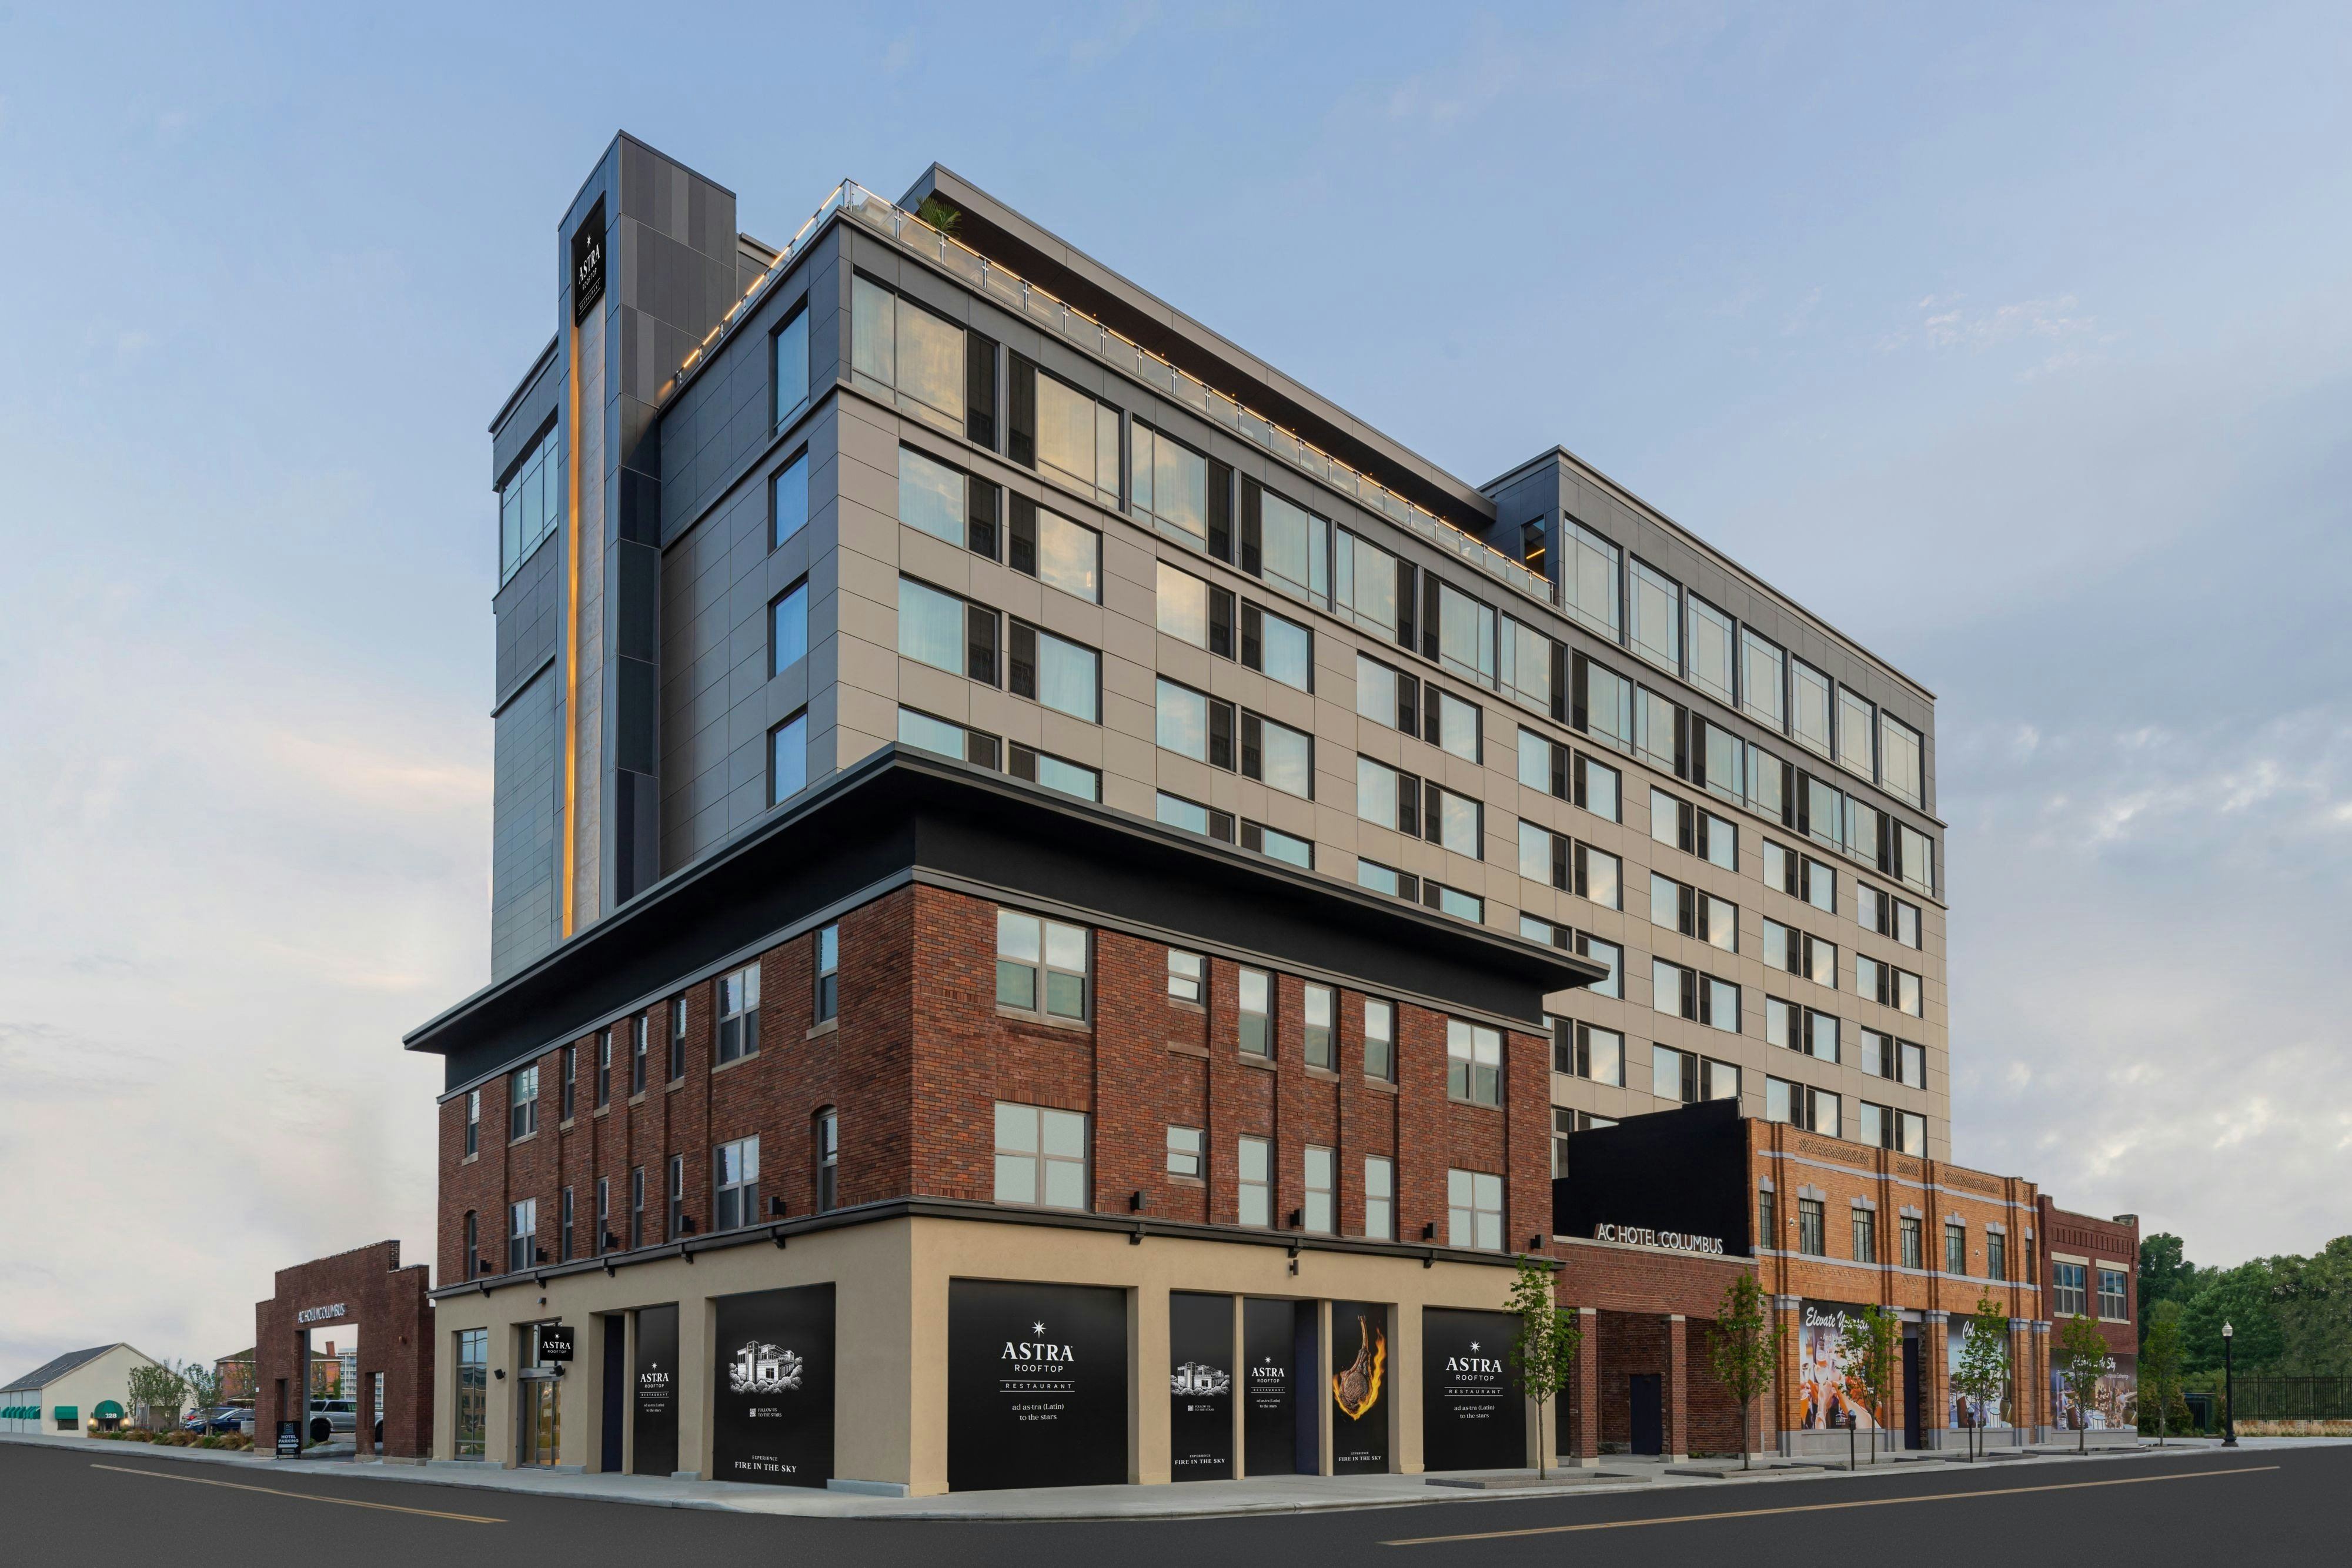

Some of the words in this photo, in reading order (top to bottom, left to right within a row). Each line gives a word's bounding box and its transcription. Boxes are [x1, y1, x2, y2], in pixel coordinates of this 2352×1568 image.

[579, 243, 600, 285] ASTRA
[582, 267, 597, 291] ROOFTOP
[1597, 1223, 1615, 1241] AC
[1618, 1226, 1658, 1246] HOTEL
[1661, 1231, 1723, 1255] COLUMBUS
[1806, 1306, 1835, 1327] Elevate
[542, 1341, 570, 1349] ASTRA
[1001, 1342, 1074, 1362] ASTRA
[1251, 1368, 1285, 1377] ASTRA
[1445, 1357, 1503, 1372] ASTRA
[640, 1373, 669, 1382] ASTRA
[735, 1461, 751, 1469] FIRE
[763, 1463, 779, 1472] THE
[781, 1465, 797, 1473] SKY
